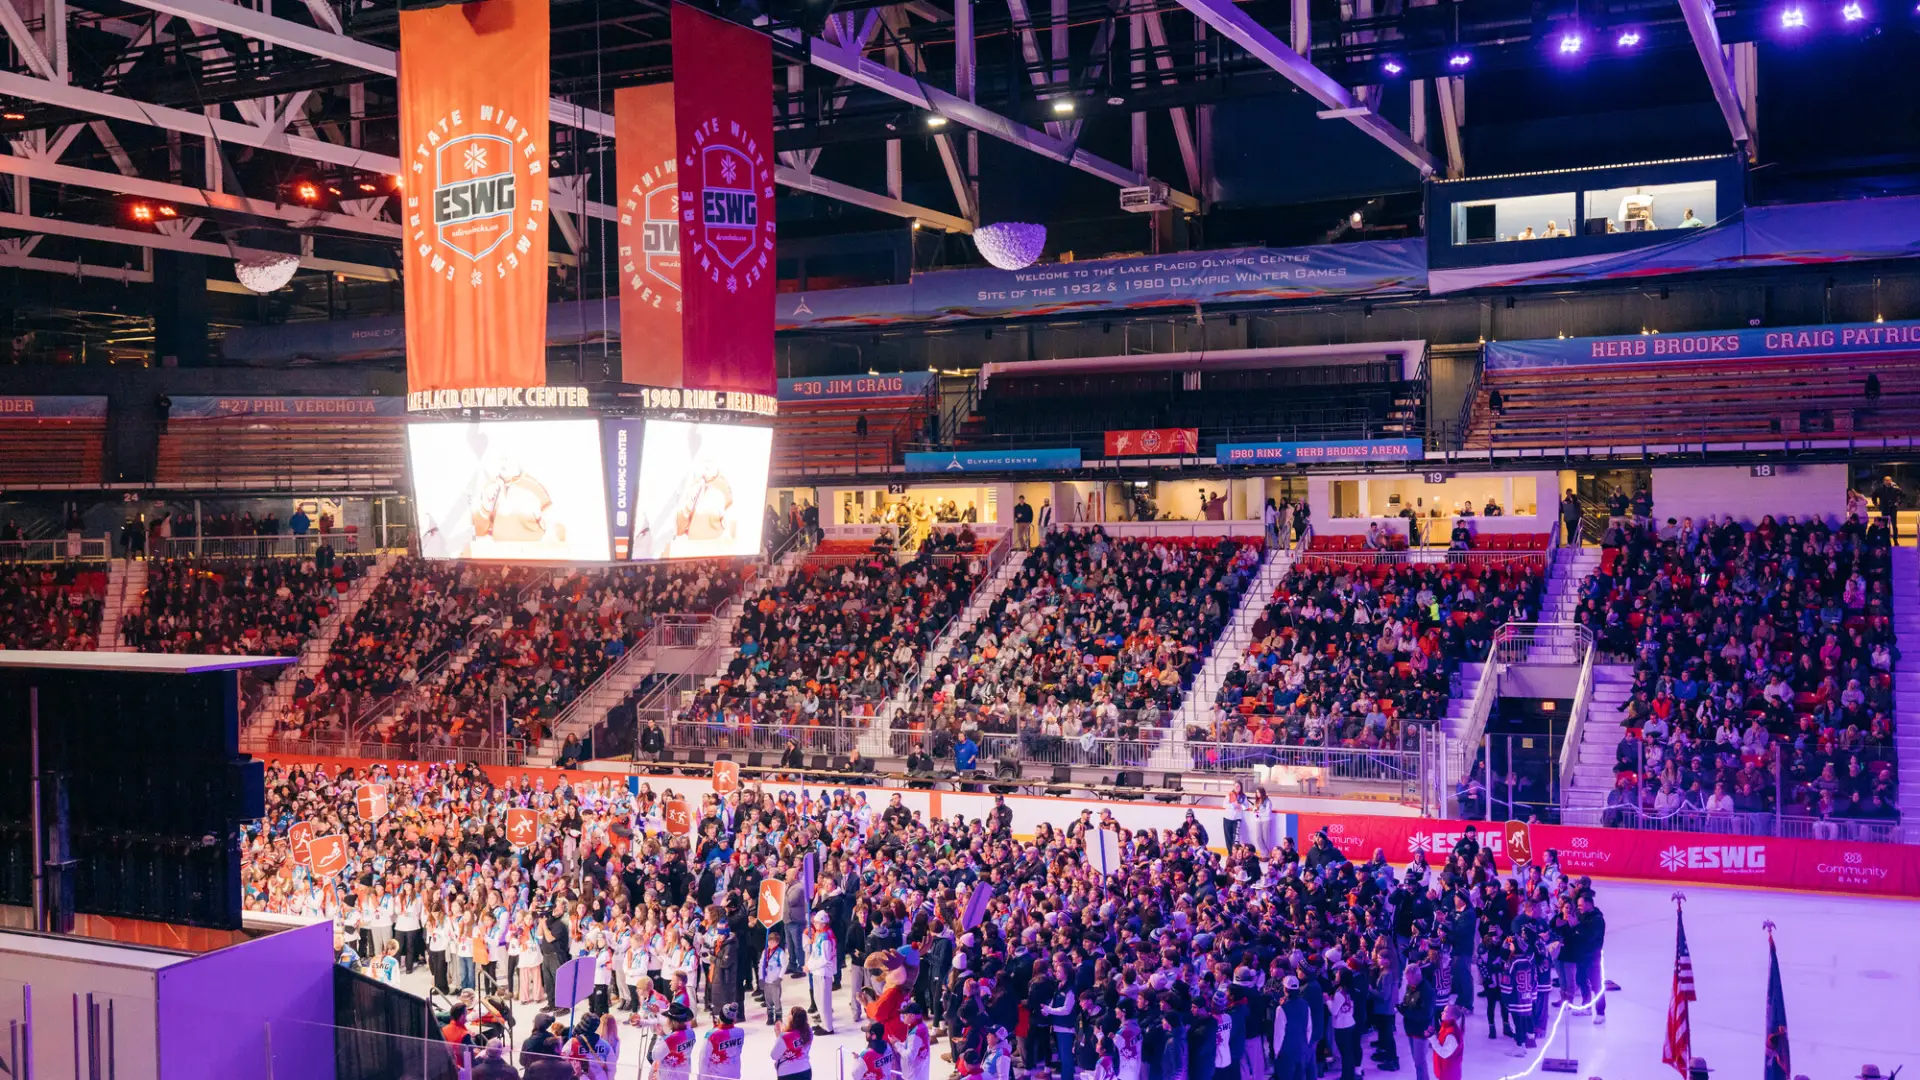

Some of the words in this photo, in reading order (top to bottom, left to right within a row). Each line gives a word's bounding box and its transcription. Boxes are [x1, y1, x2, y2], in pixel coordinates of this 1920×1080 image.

[413, 109, 463, 174] STATE
[480, 105, 542, 175] WINTER
[435, 176, 515, 223] ESWG
[703, 190, 757, 226] ESWG
[408, 196, 455, 281] EMPIRE
[496, 199, 543, 279] GAMES
[1015, 271, 1069, 282] WELCOME
[1074, 270, 1088, 278] TO
[1093, 268, 1115, 277] THE
[1120, 263, 1149, 274] LAKE
[1154, 262, 1197, 272] PLACID
[1202, 257, 1255, 268] OLYMPIC
[1260, 254, 1310, 264] CENTER
[977, 290, 1006, 301] SITE
[1011, 289, 1026, 299] OF
[1031, 287, 1056, 297] THE
[1063, 283, 1101, 295] 1932
[1107, 281, 1117, 292] &
[1124, 278, 1164, 291] 1980
[1170, 275, 1230, 288] OLYMPIC
[1236, 271, 1289, 283] WINTER
[1295, 268, 1347, 279] GAMES
[1591, 340, 1647, 358] HERB
[1653, 335, 1740, 355] BROOKS
[1765, 330, 1835, 349] CRAIG
[1842, 326, 1920, 346] PATRIC
[423, 389, 460, 410] PLACID
[460, 387, 525, 409] OLYMPIC
[525, 386, 589, 407] CENTER
[793, 381, 822, 395] #30
[826, 379, 853, 394] JIM
[856, 377, 902, 393] CRAIG
[219, 399, 249, 413] #27
[253, 399, 289, 413] PHIL
[294, 399, 376, 413] VERCHOTA
[641, 388, 681, 408] 1980
[683, 389, 717, 409] RINK
[726, 391, 753, 412] HERB
[617, 429, 627, 467] CENTER
[1230, 449, 1254, 458] 1980
[1256, 448, 1282, 458] RINK
[1296, 447, 1324, 457] HERB
[1326, 446, 1368, 456] BROOKS
[1371, 445, 1408, 455] ARENA
[1428, 472, 1442, 483] 19
[1755, 464, 1770, 477] 18
[123, 492, 139, 502] 24
[617, 467, 627, 509] OLYMPIC
[891, 484, 903, 494] 21
[1557, 850, 1611, 862] ommunity
[1567, 859, 1594, 867] BANK
[1687, 845, 1766, 869] ESWG
[1817, 863, 1888, 878] Community
[1838, 875, 1868, 884] BANK
